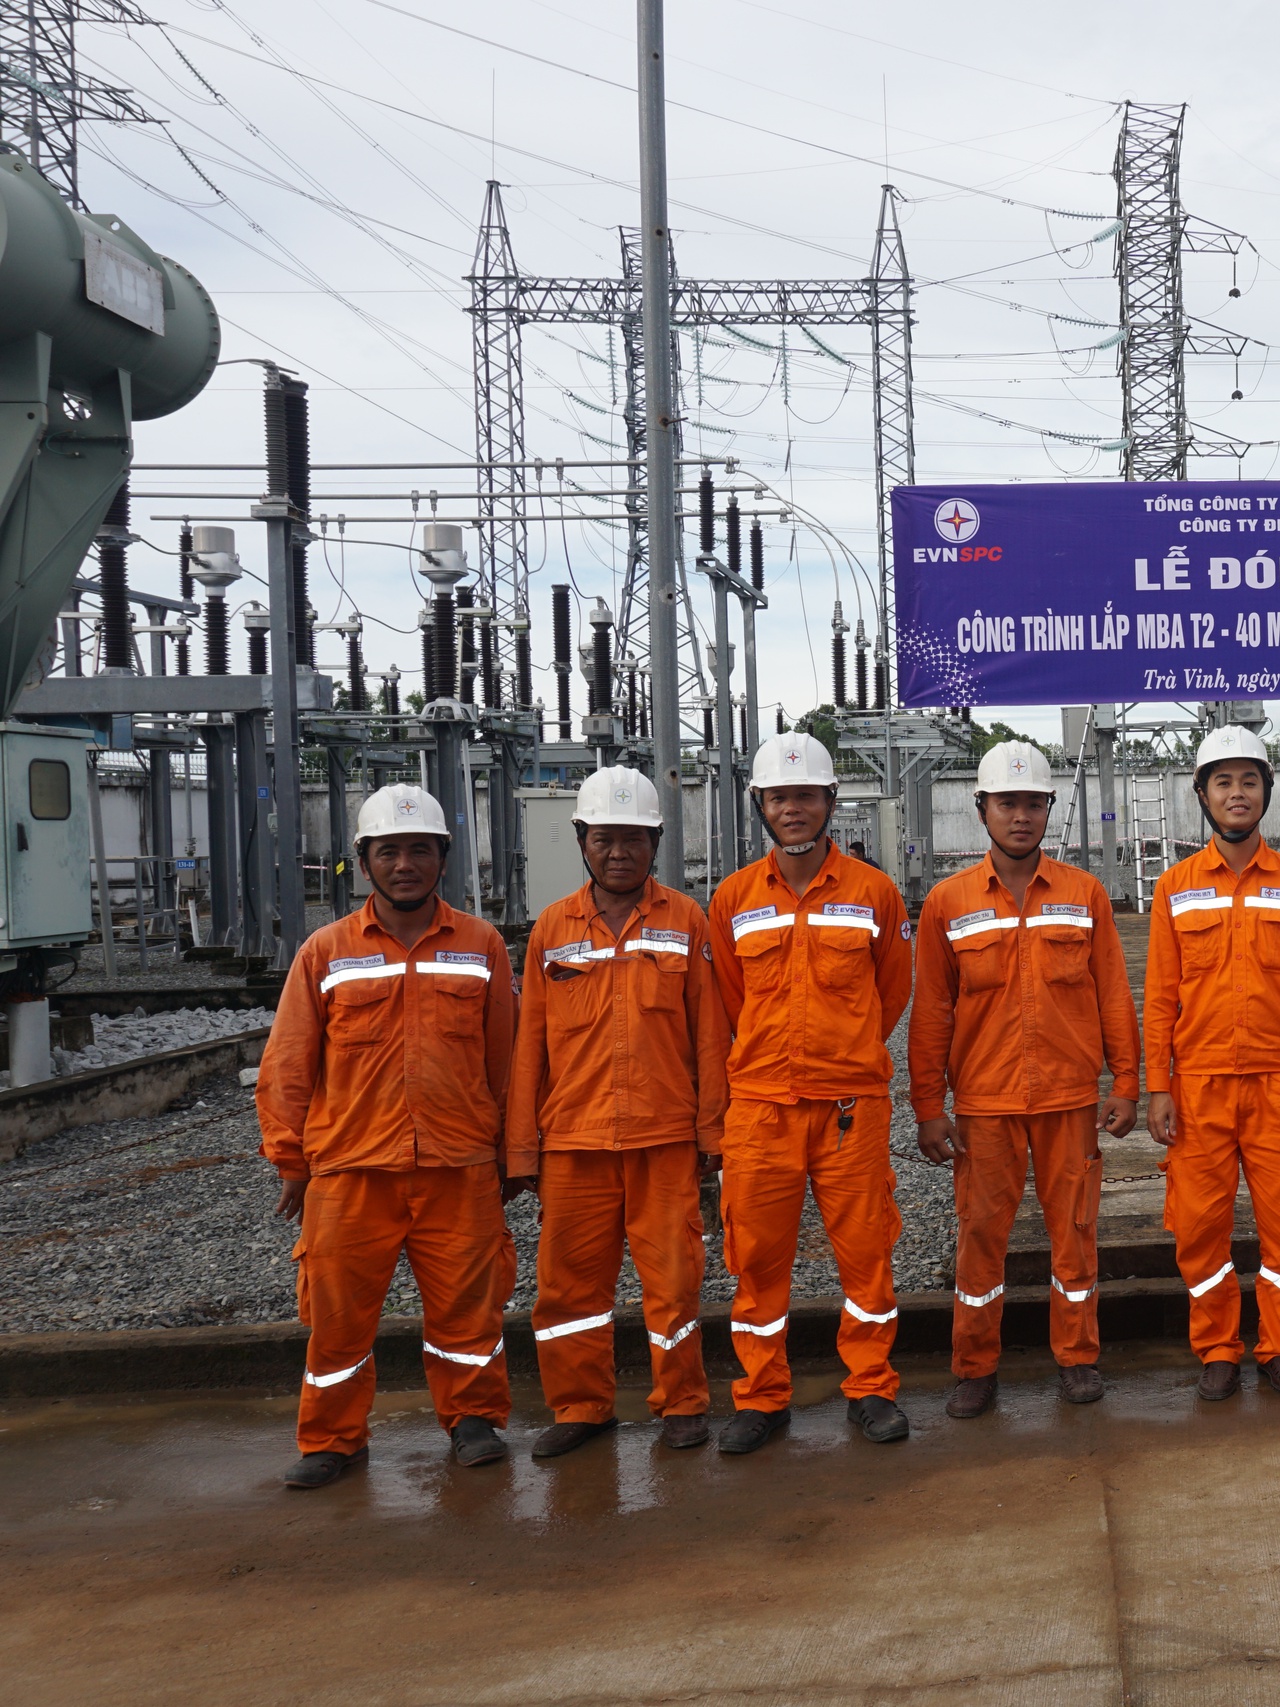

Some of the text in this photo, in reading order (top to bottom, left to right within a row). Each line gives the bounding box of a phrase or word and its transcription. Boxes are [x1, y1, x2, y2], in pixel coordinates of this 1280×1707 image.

[1143, 493, 1194, 512] TỔNG
[1199, 495, 1251, 512] CÔNG
[1256, 497, 1279, 511] TY
[1179, 516, 1231, 533] CÔNG
[1236, 518, 1259, 532] TY
[913, 546, 1003, 563] EVNSPC
[1134, 545, 1191, 591] LỄ
[957, 609, 1016, 654] CÔNG
[1021, 607, 1085, 652] TRÌNH
[1090, 600, 1130, 651] LẮP
[1136, 613, 1186, 650] MBA
[1189, 612, 1215, 649] T2
[1235, 612, 1261, 648] 40
[1144, 669, 1177, 690] Trà
[1183, 667, 1230, 693] Vinh,
[1236, 667, 1280, 693] ngày
[839, 906, 871, 916] EVNSPC
[1056, 906, 1084, 915] EVNSPC
[656, 931, 686, 942] EVNSPC
[453, 955, 485, 963] EVNSPC
